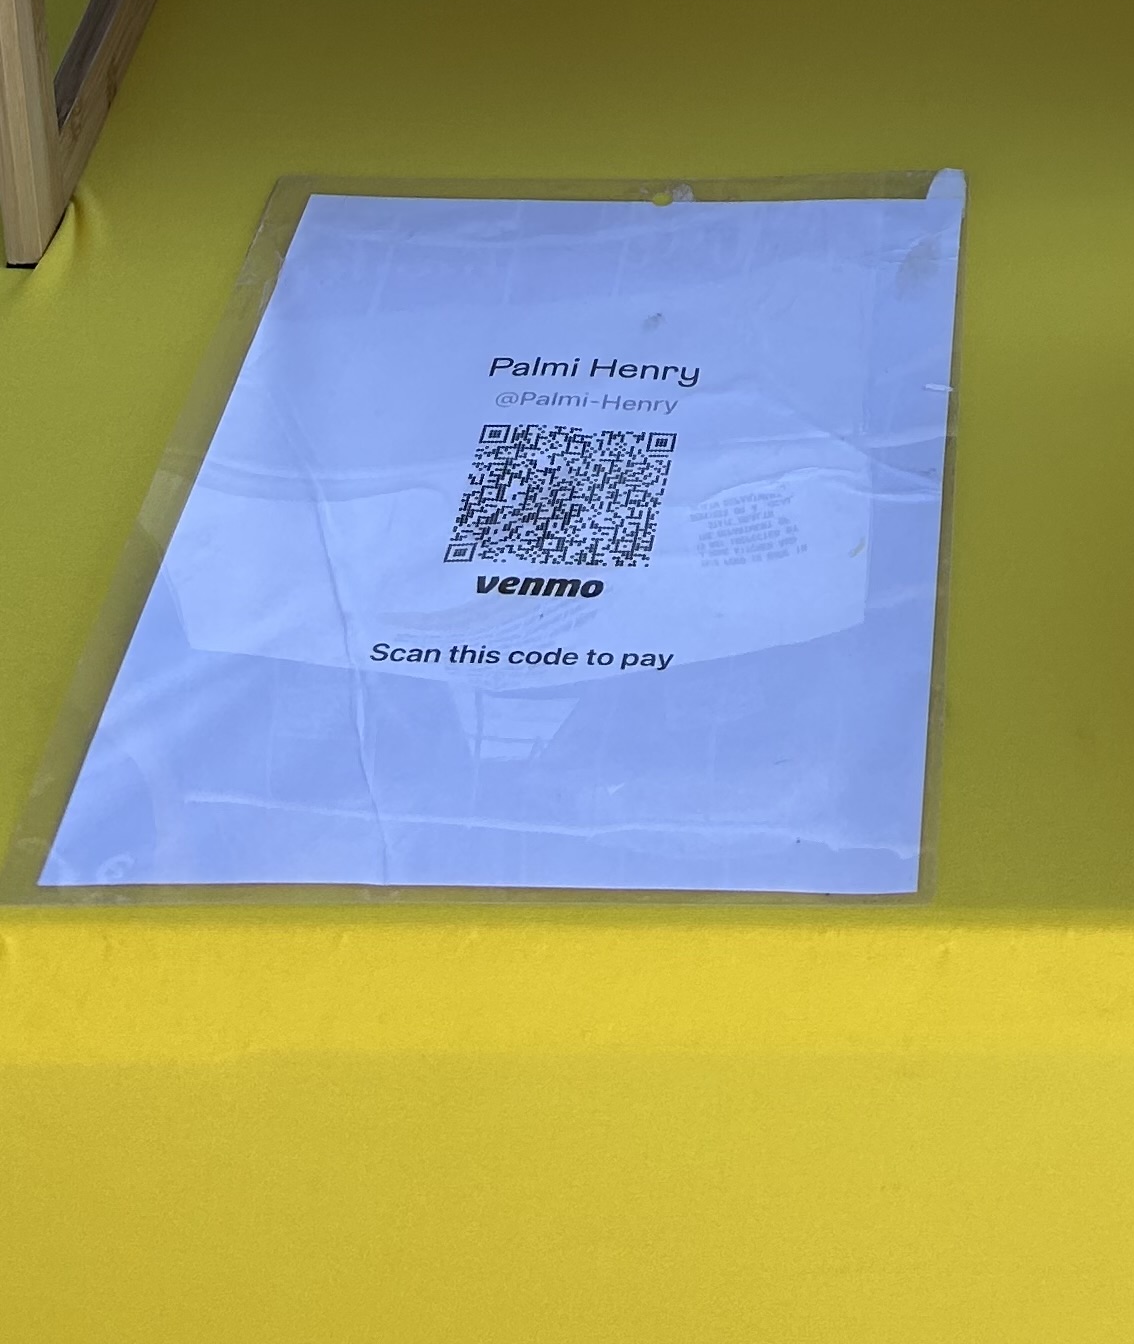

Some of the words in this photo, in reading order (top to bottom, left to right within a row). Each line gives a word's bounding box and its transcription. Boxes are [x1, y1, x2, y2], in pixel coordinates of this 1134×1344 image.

[488, 356, 580, 379] Palmi
[589, 358, 701, 388] Henry
[494, 391, 680, 416] @Palmi-Henry
[475, 574, 606, 599] venmo
[369, 643, 442, 665] Scan
[448, 644, 501, 665] this
[507, 647, 579, 666] code
[586, 648, 615, 666] to
[620, 652, 675, 671] pay
